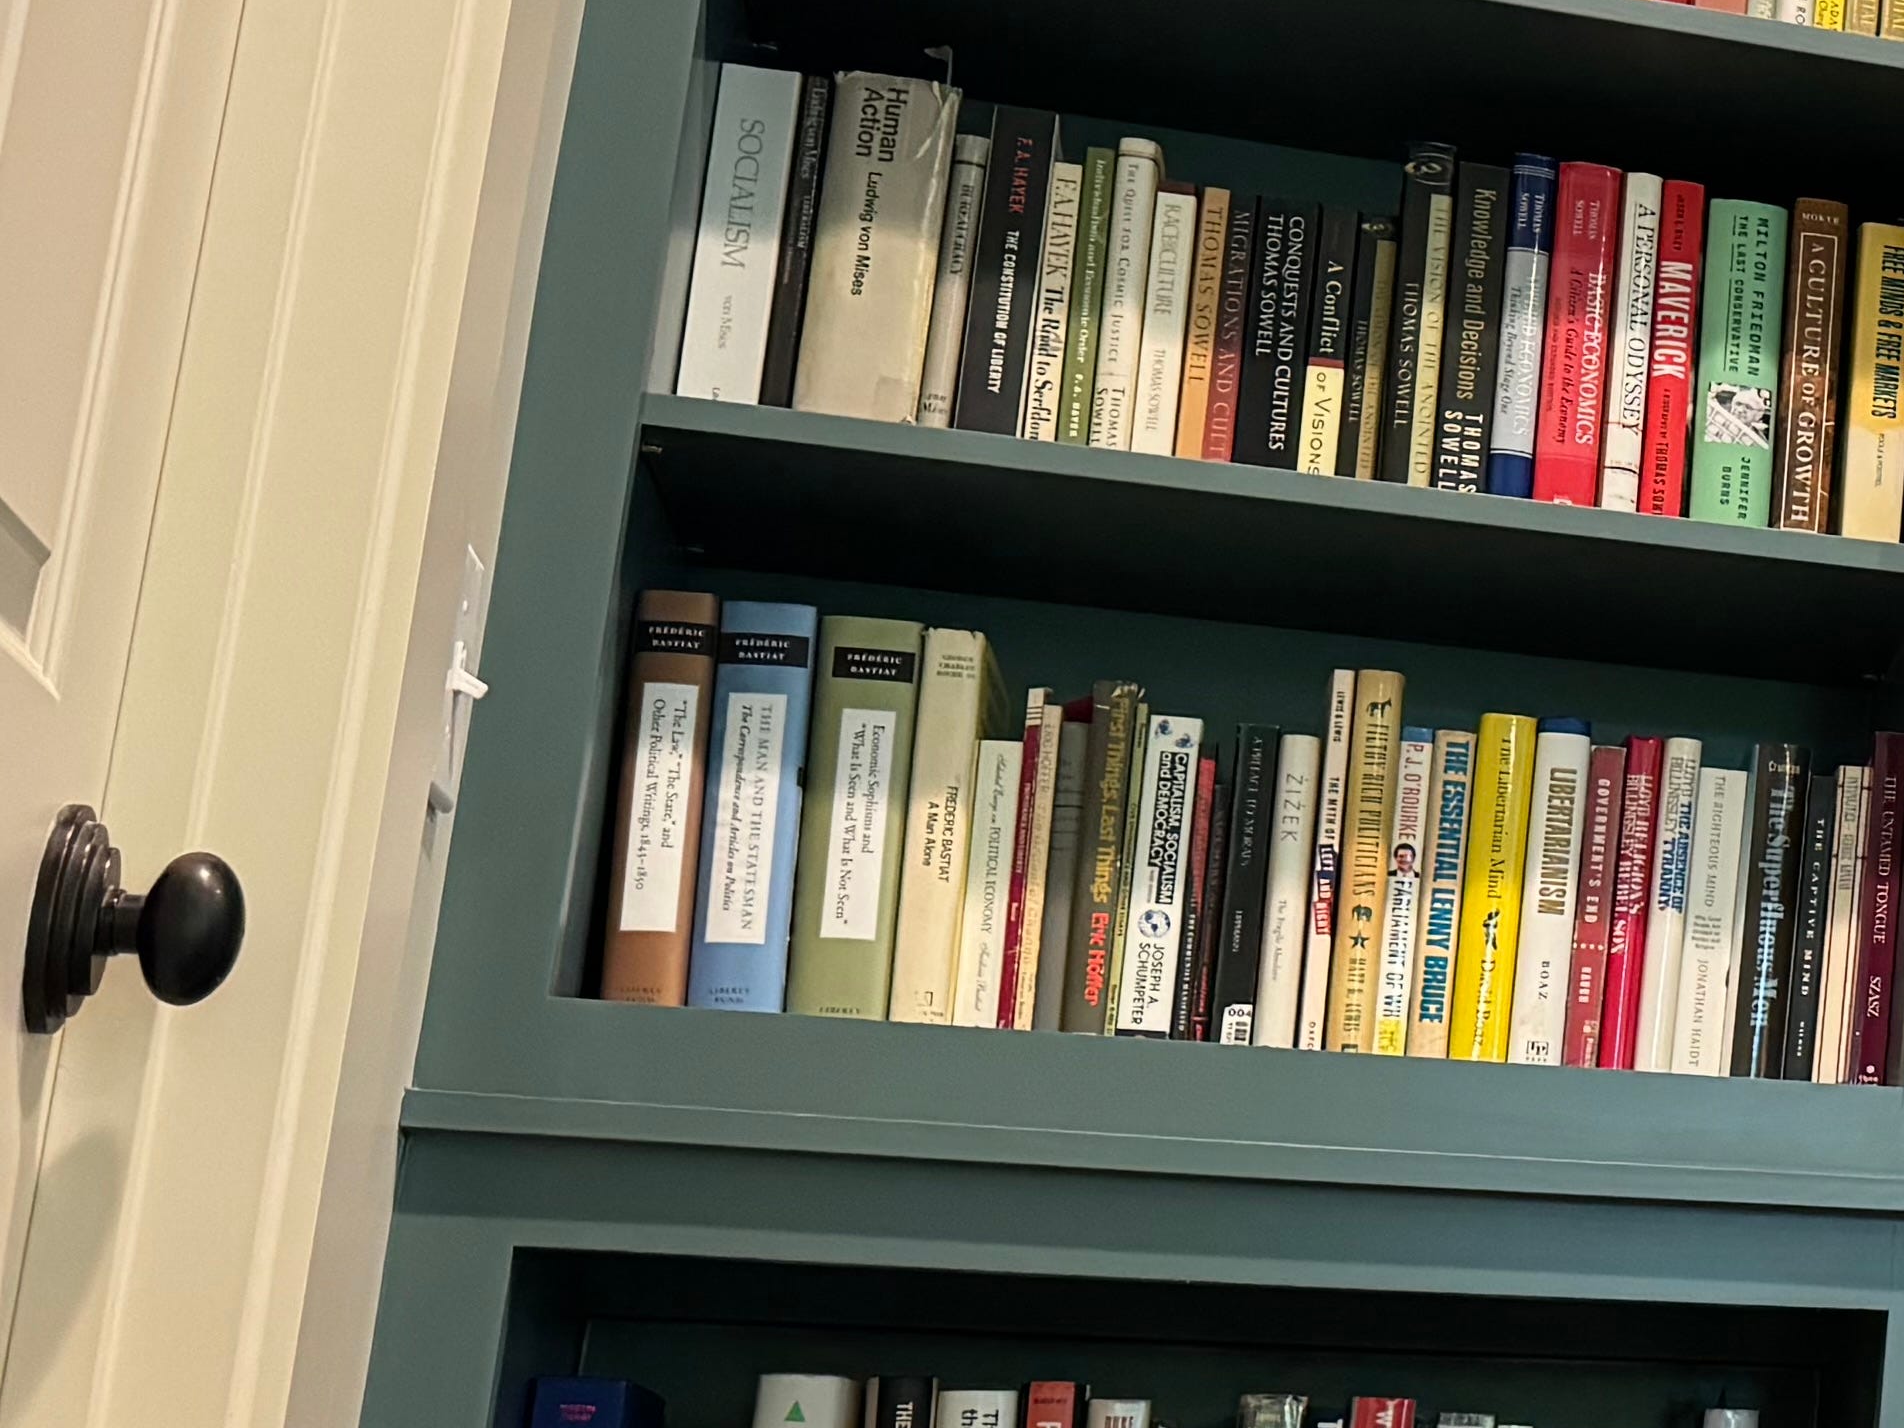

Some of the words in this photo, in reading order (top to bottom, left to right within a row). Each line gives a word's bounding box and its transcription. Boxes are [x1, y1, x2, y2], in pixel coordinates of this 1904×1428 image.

[854, 88, 884, 158] Action
[876, 88, 909, 163] Human
[720, 119, 764, 271] SOCIALISM
[858, 171, 884, 223] Ludwig
[859, 224, 874, 251] von
[1754, 218, 1770, 282] MILTON
[850, 252, 870, 296] Mises
[1655, 260, 1695, 379] MAVERICK
[1748, 287, 1767, 376] FRIEDMAN
